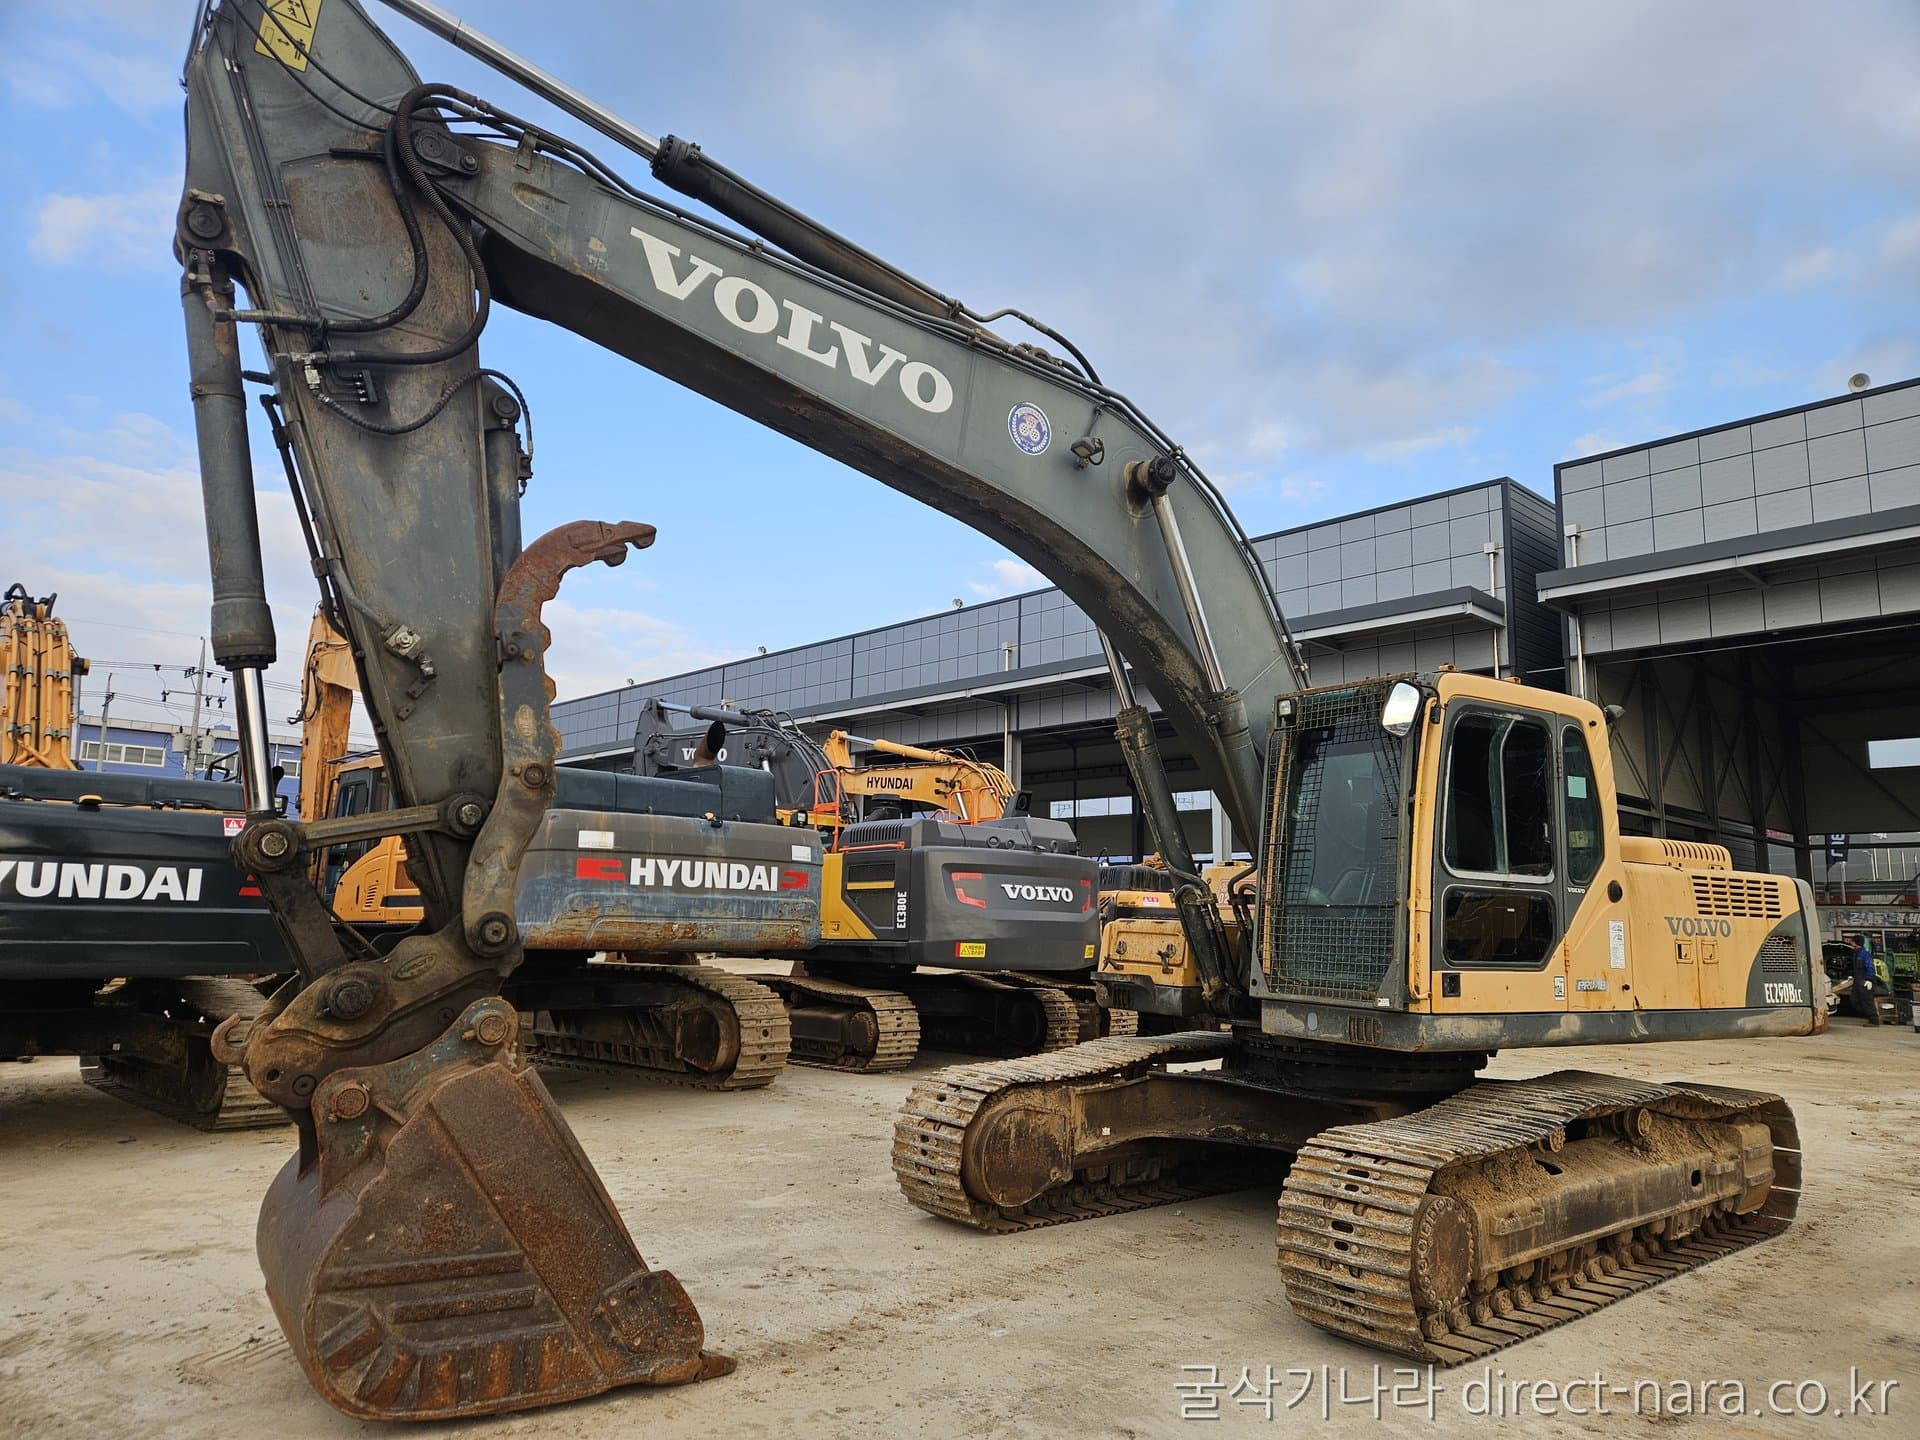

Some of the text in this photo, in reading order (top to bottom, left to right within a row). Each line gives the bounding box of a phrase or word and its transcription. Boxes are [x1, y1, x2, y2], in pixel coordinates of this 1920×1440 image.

[630, 226, 953, 413] VOLVO
[866, 776, 913, 790] HYUNDAI
[629, 857, 779, 892] HYUNDAI
[1001, 883, 1074, 902] VOLVO
[1567, 886, 1586, 895] VOLVO
[896, 891, 907, 929] EC380E
[1664, 916, 1731, 938] VOLVO
